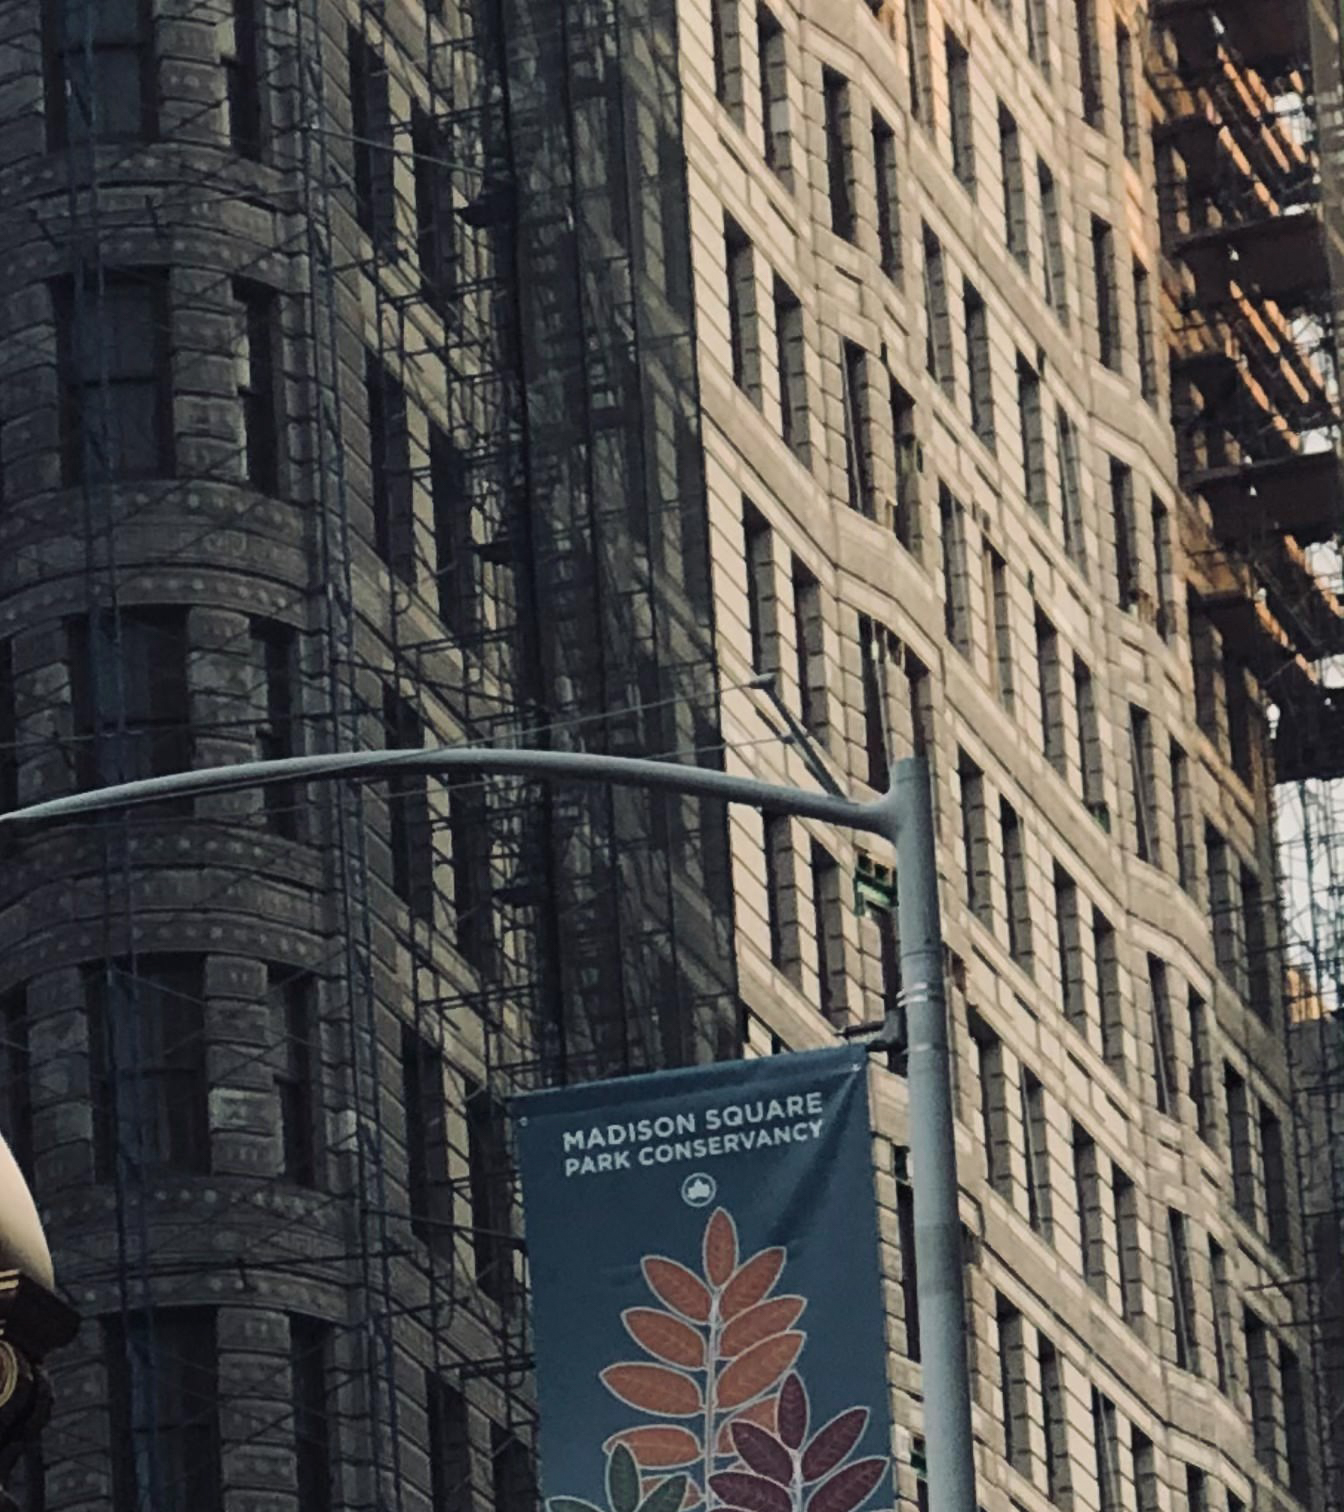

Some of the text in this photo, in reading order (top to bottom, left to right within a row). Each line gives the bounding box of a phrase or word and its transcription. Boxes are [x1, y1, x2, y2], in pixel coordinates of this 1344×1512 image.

[562, 1091, 823, 1152] MADISON SQUARE
[564, 1119, 824, 1177] PARK CONSERVANCY
